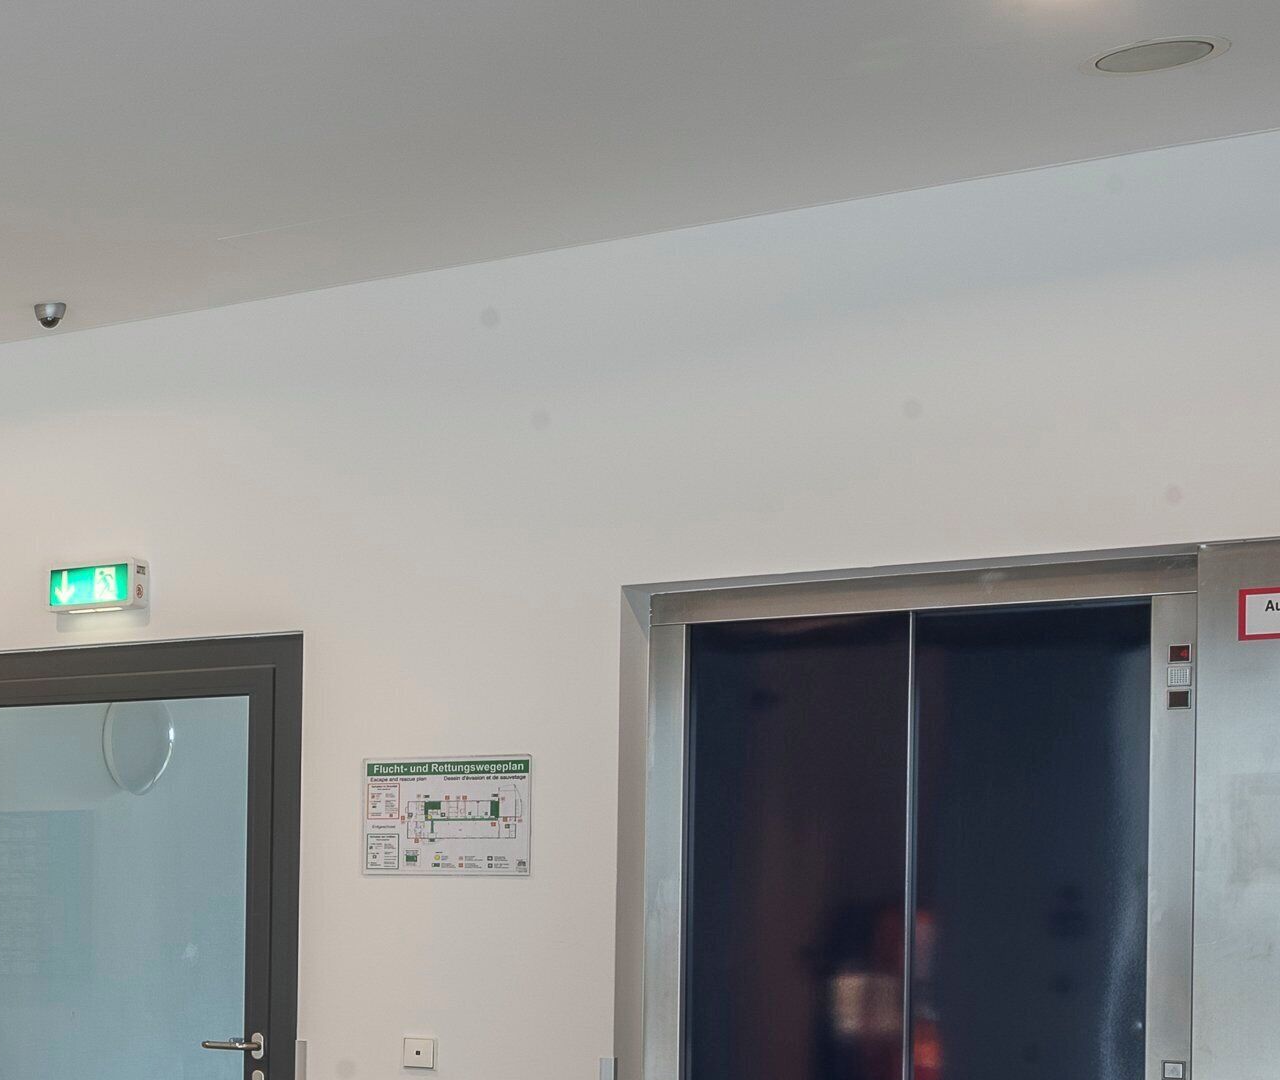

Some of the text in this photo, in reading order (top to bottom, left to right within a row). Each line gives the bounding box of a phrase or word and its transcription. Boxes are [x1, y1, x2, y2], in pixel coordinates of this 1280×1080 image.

[373, 762, 524, 775] Flucht- und Rettungswegeplan
